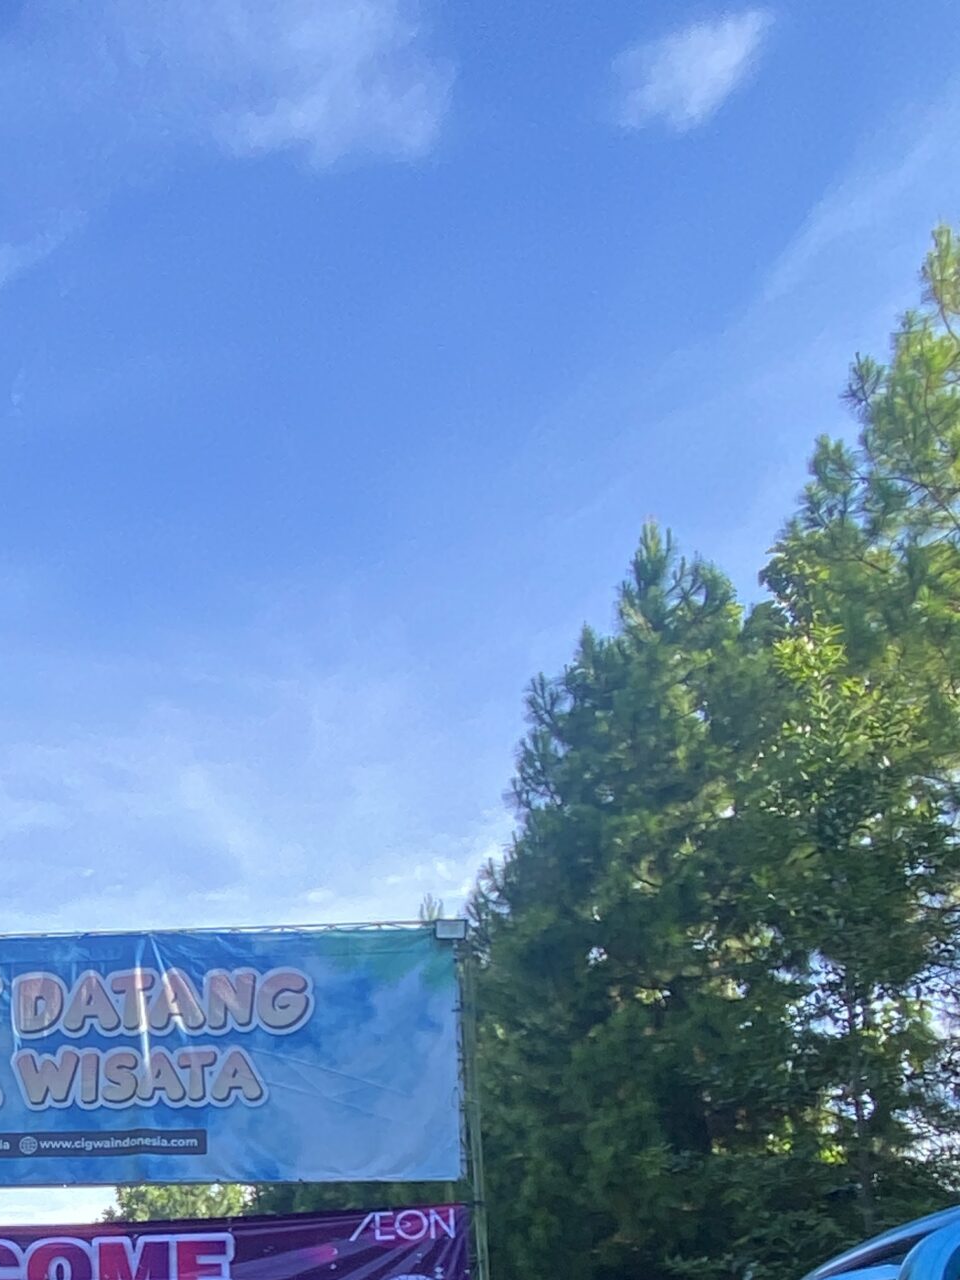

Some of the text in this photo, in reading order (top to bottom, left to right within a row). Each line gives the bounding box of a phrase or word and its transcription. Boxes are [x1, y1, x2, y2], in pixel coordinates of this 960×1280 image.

[11, 967, 315, 1039] DATANG
[11, 1046, 269, 1110] WISATA
[40, 1135, 198, 1152] www.cigwaindonesia.com
